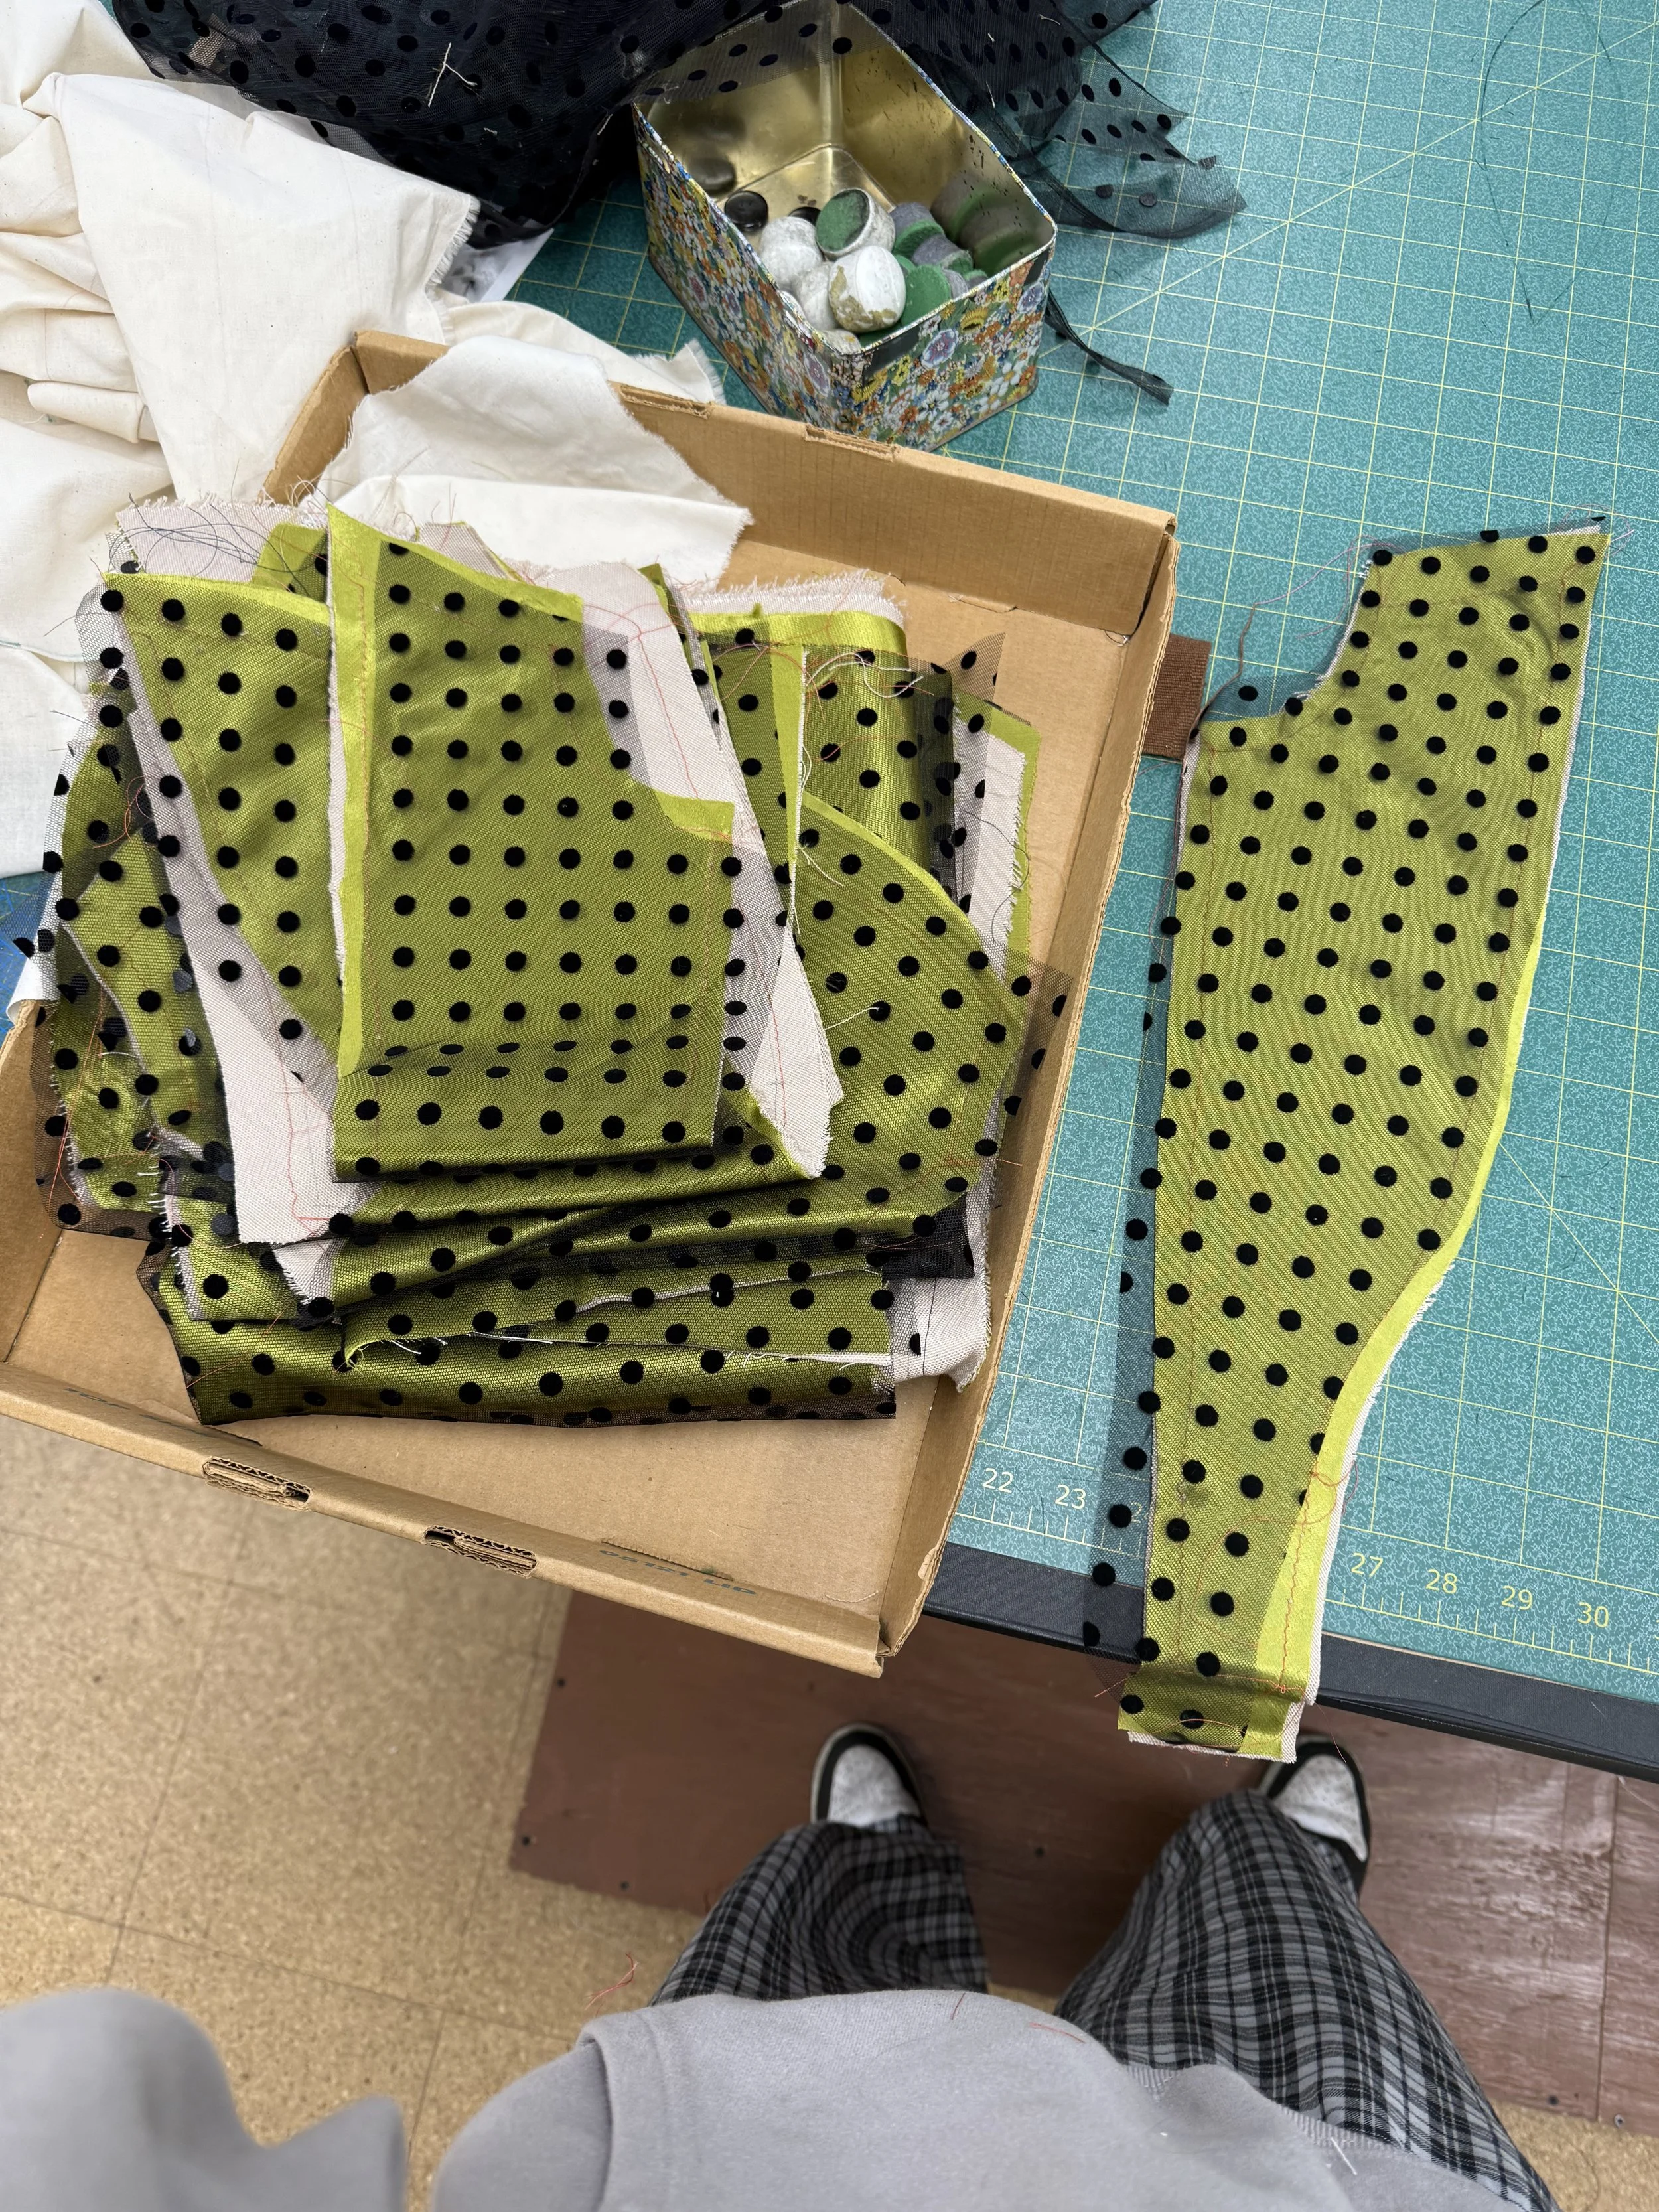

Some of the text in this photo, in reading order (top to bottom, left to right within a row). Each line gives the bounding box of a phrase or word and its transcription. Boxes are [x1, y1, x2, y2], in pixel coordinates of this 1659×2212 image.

[982, 1467, 1014, 1493] 22
[1054, 1484, 1086, 1509] 23
[1350, 1552, 1384, 1578] 27
[1425, 1568, 1458, 1594] 28
[1500, 1585, 1534, 1611] 29
[1577, 1601, 1610, 1628] 30
